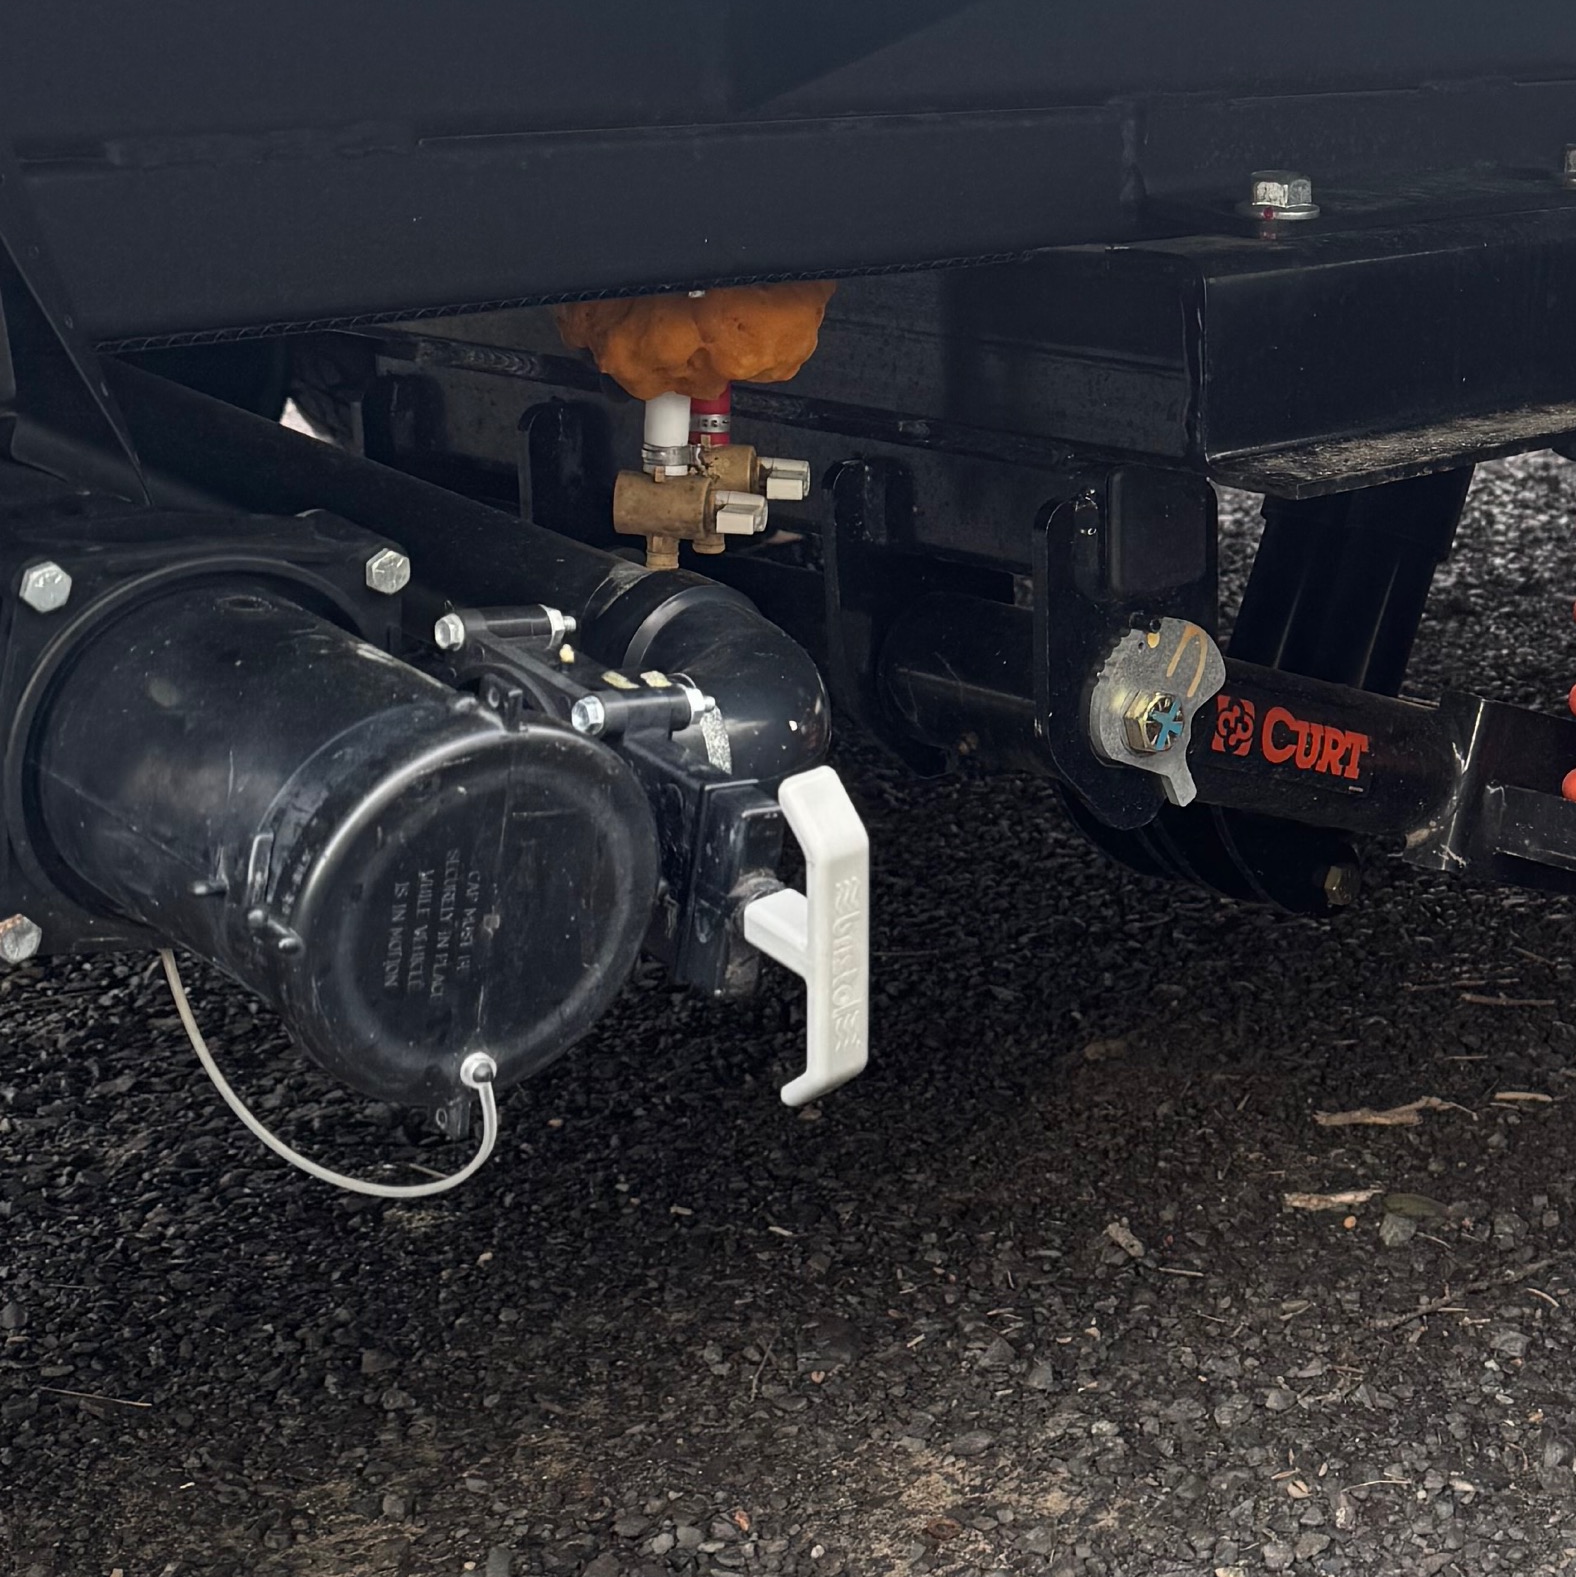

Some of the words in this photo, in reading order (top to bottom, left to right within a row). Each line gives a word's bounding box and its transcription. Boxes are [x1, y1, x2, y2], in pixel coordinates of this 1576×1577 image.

[1262, 706, 1369, 780] CURT
[393, 881, 410, 899] IS
[416, 869, 436, 920] WHILE
[439, 847, 461, 923] SECURELY
[465, 869, 481, 903] CAP
[391, 903, 407, 923] IN
[459, 907, 477, 948] MUST
[383, 926, 405, 989] MOTION
[436, 931, 452, 949] IN
